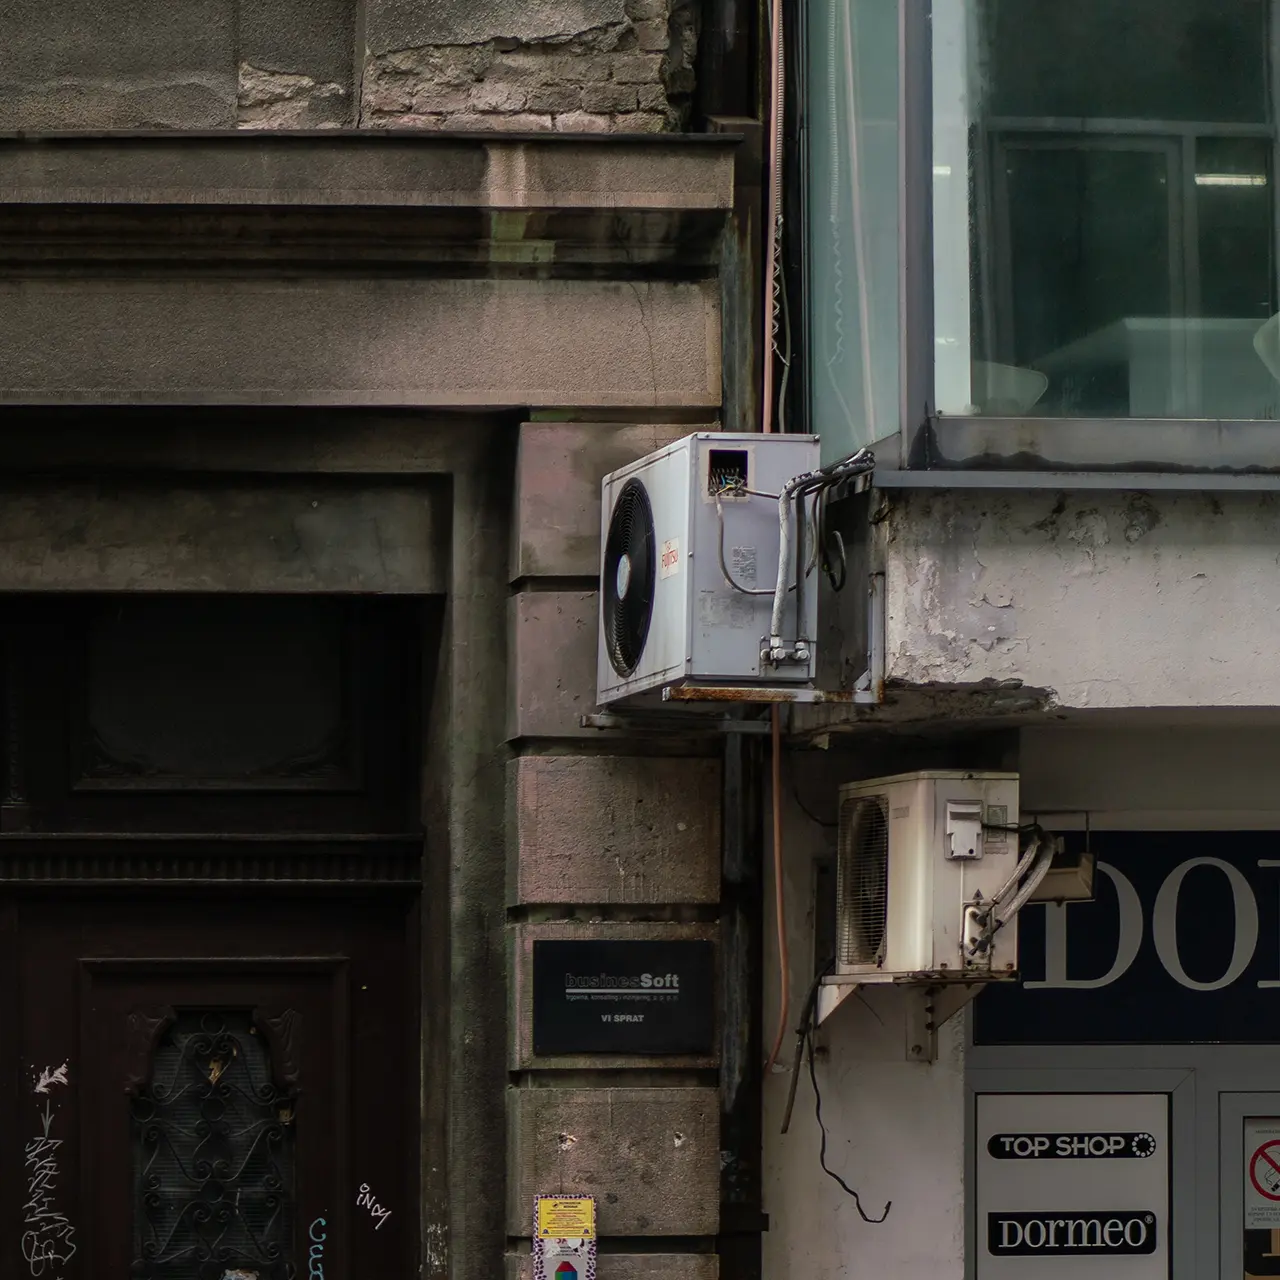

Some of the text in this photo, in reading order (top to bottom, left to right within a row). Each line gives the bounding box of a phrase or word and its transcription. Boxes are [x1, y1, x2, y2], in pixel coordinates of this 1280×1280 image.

[1023, 856, 1280, 992] DO
[600, 1014, 645, 1022] VI SPRAT
[1000, 1136, 1126, 1157] TOP SHOP
